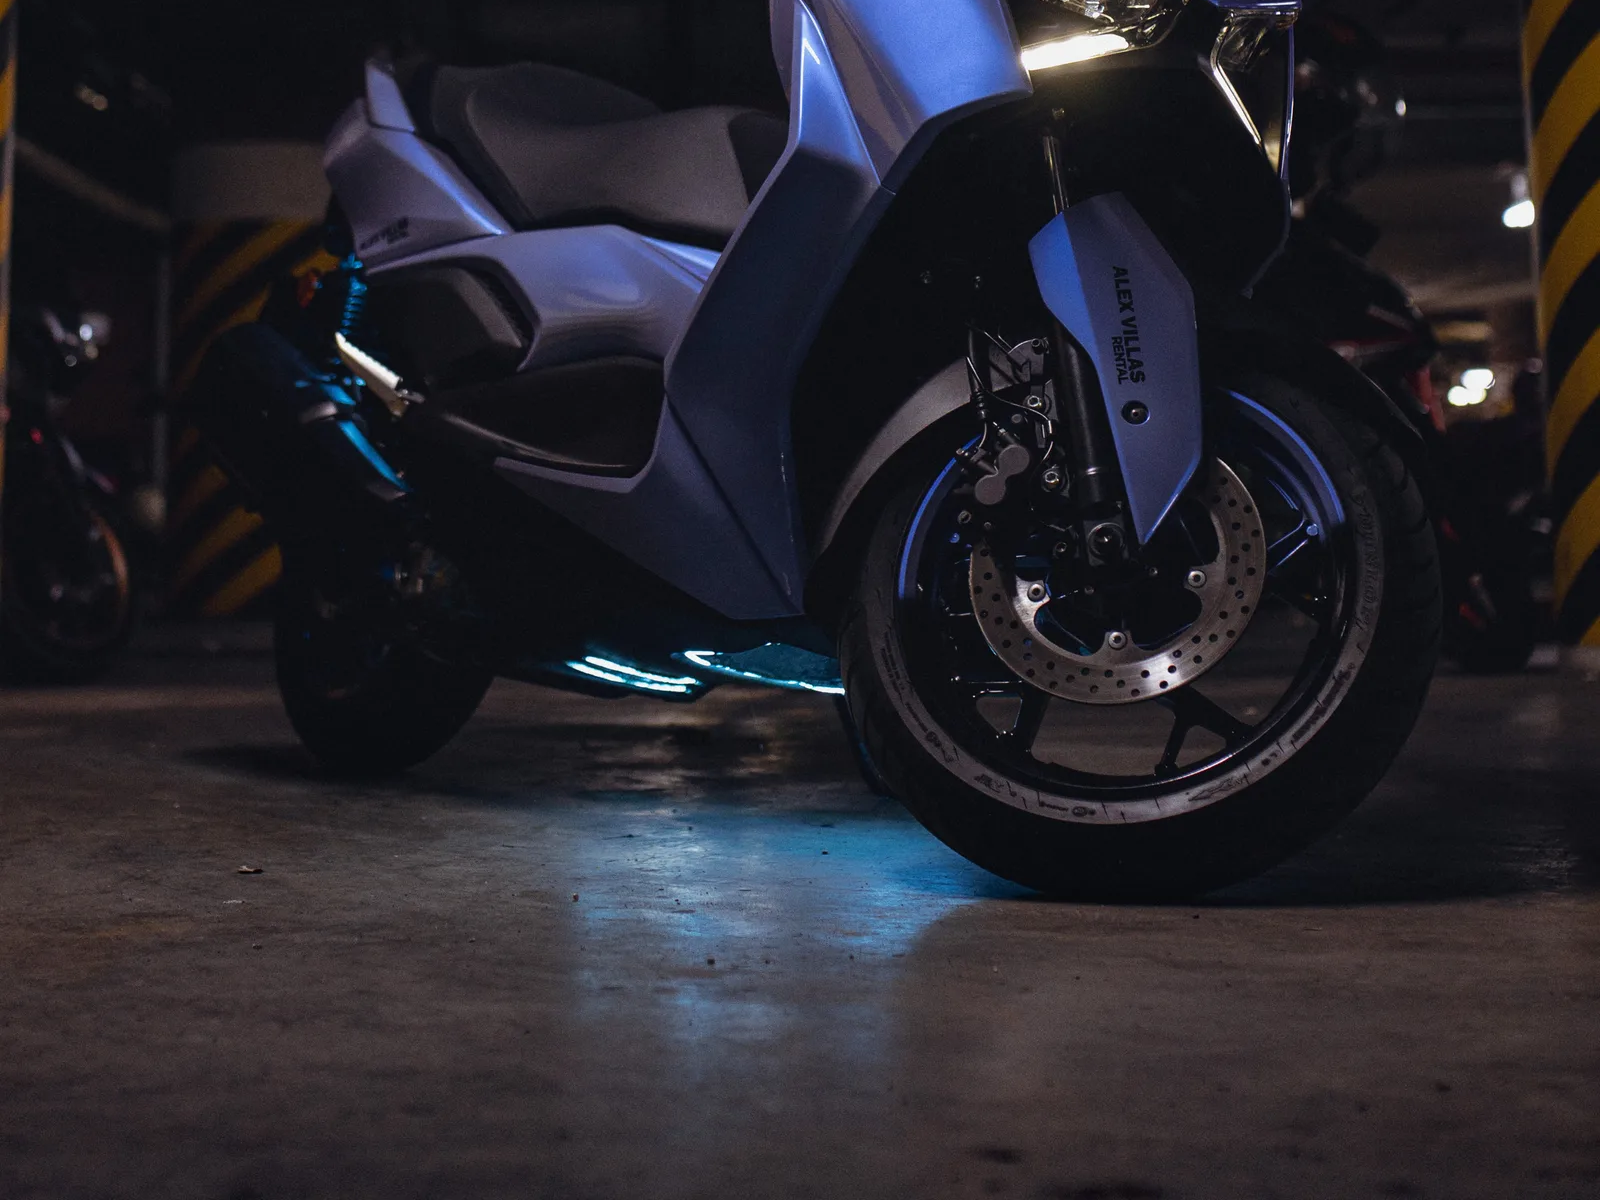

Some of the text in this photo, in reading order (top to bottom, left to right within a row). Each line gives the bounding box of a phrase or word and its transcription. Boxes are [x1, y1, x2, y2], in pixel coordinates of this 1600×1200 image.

[1111, 335, 1129, 385] RENTAL
[1112, 265, 1146, 384] ALEX VILLAS
